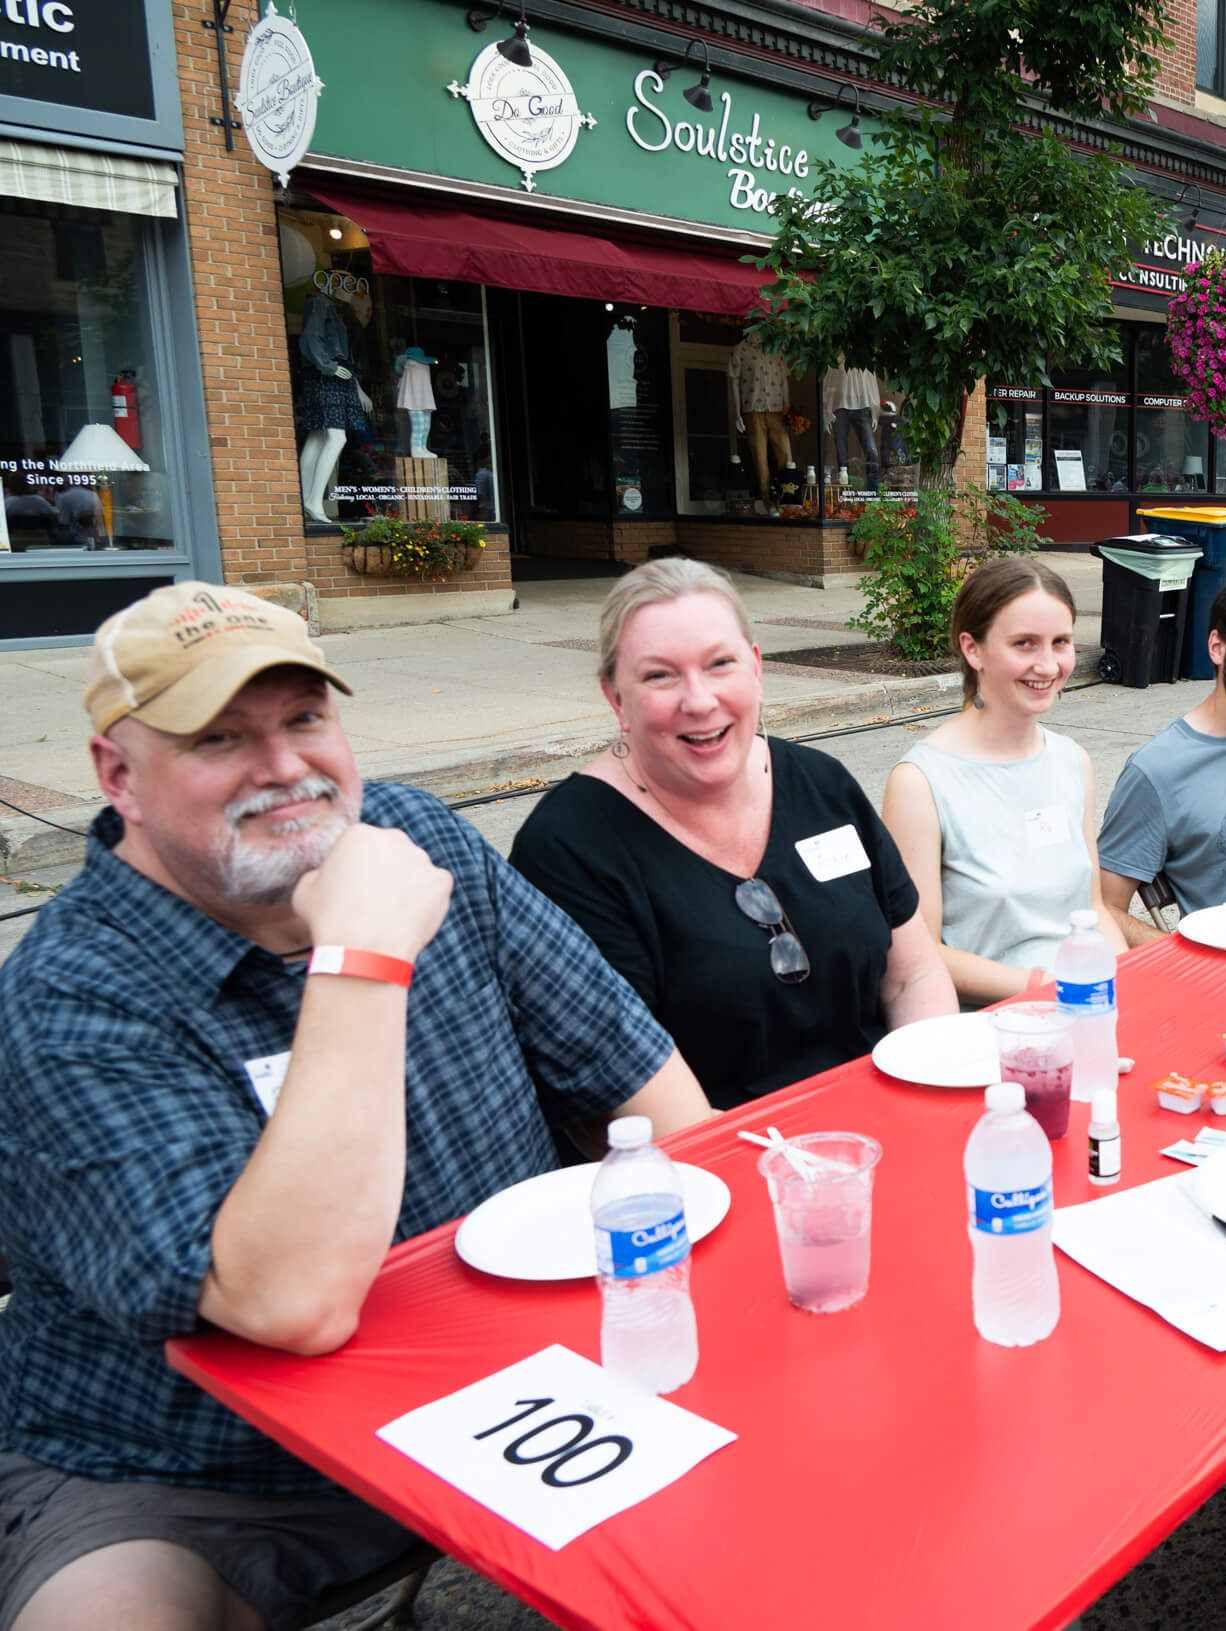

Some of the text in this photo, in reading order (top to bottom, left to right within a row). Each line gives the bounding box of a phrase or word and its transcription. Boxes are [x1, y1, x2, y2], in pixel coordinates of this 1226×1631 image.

[0, 0, 75, 33] tic
[0, 41, 81, 72] ment
[491, 96, 564, 122] Do Good
[625, 69, 809, 178] Soulstice
[312, 270, 370, 297] open
[1008, 389, 1036, 399] REPAIR
[1054, 392, 1126, 405] BACKUP SOLUTIONS
[1143, 397, 1182, 407] COMPUTER
[21, 459, 45, 470] the
[121, 463, 151, 472] Area
[26, 474, 97, 486] Since 1995
[176, 620, 214, 642] the
[472, 1397, 634, 1489] 100
